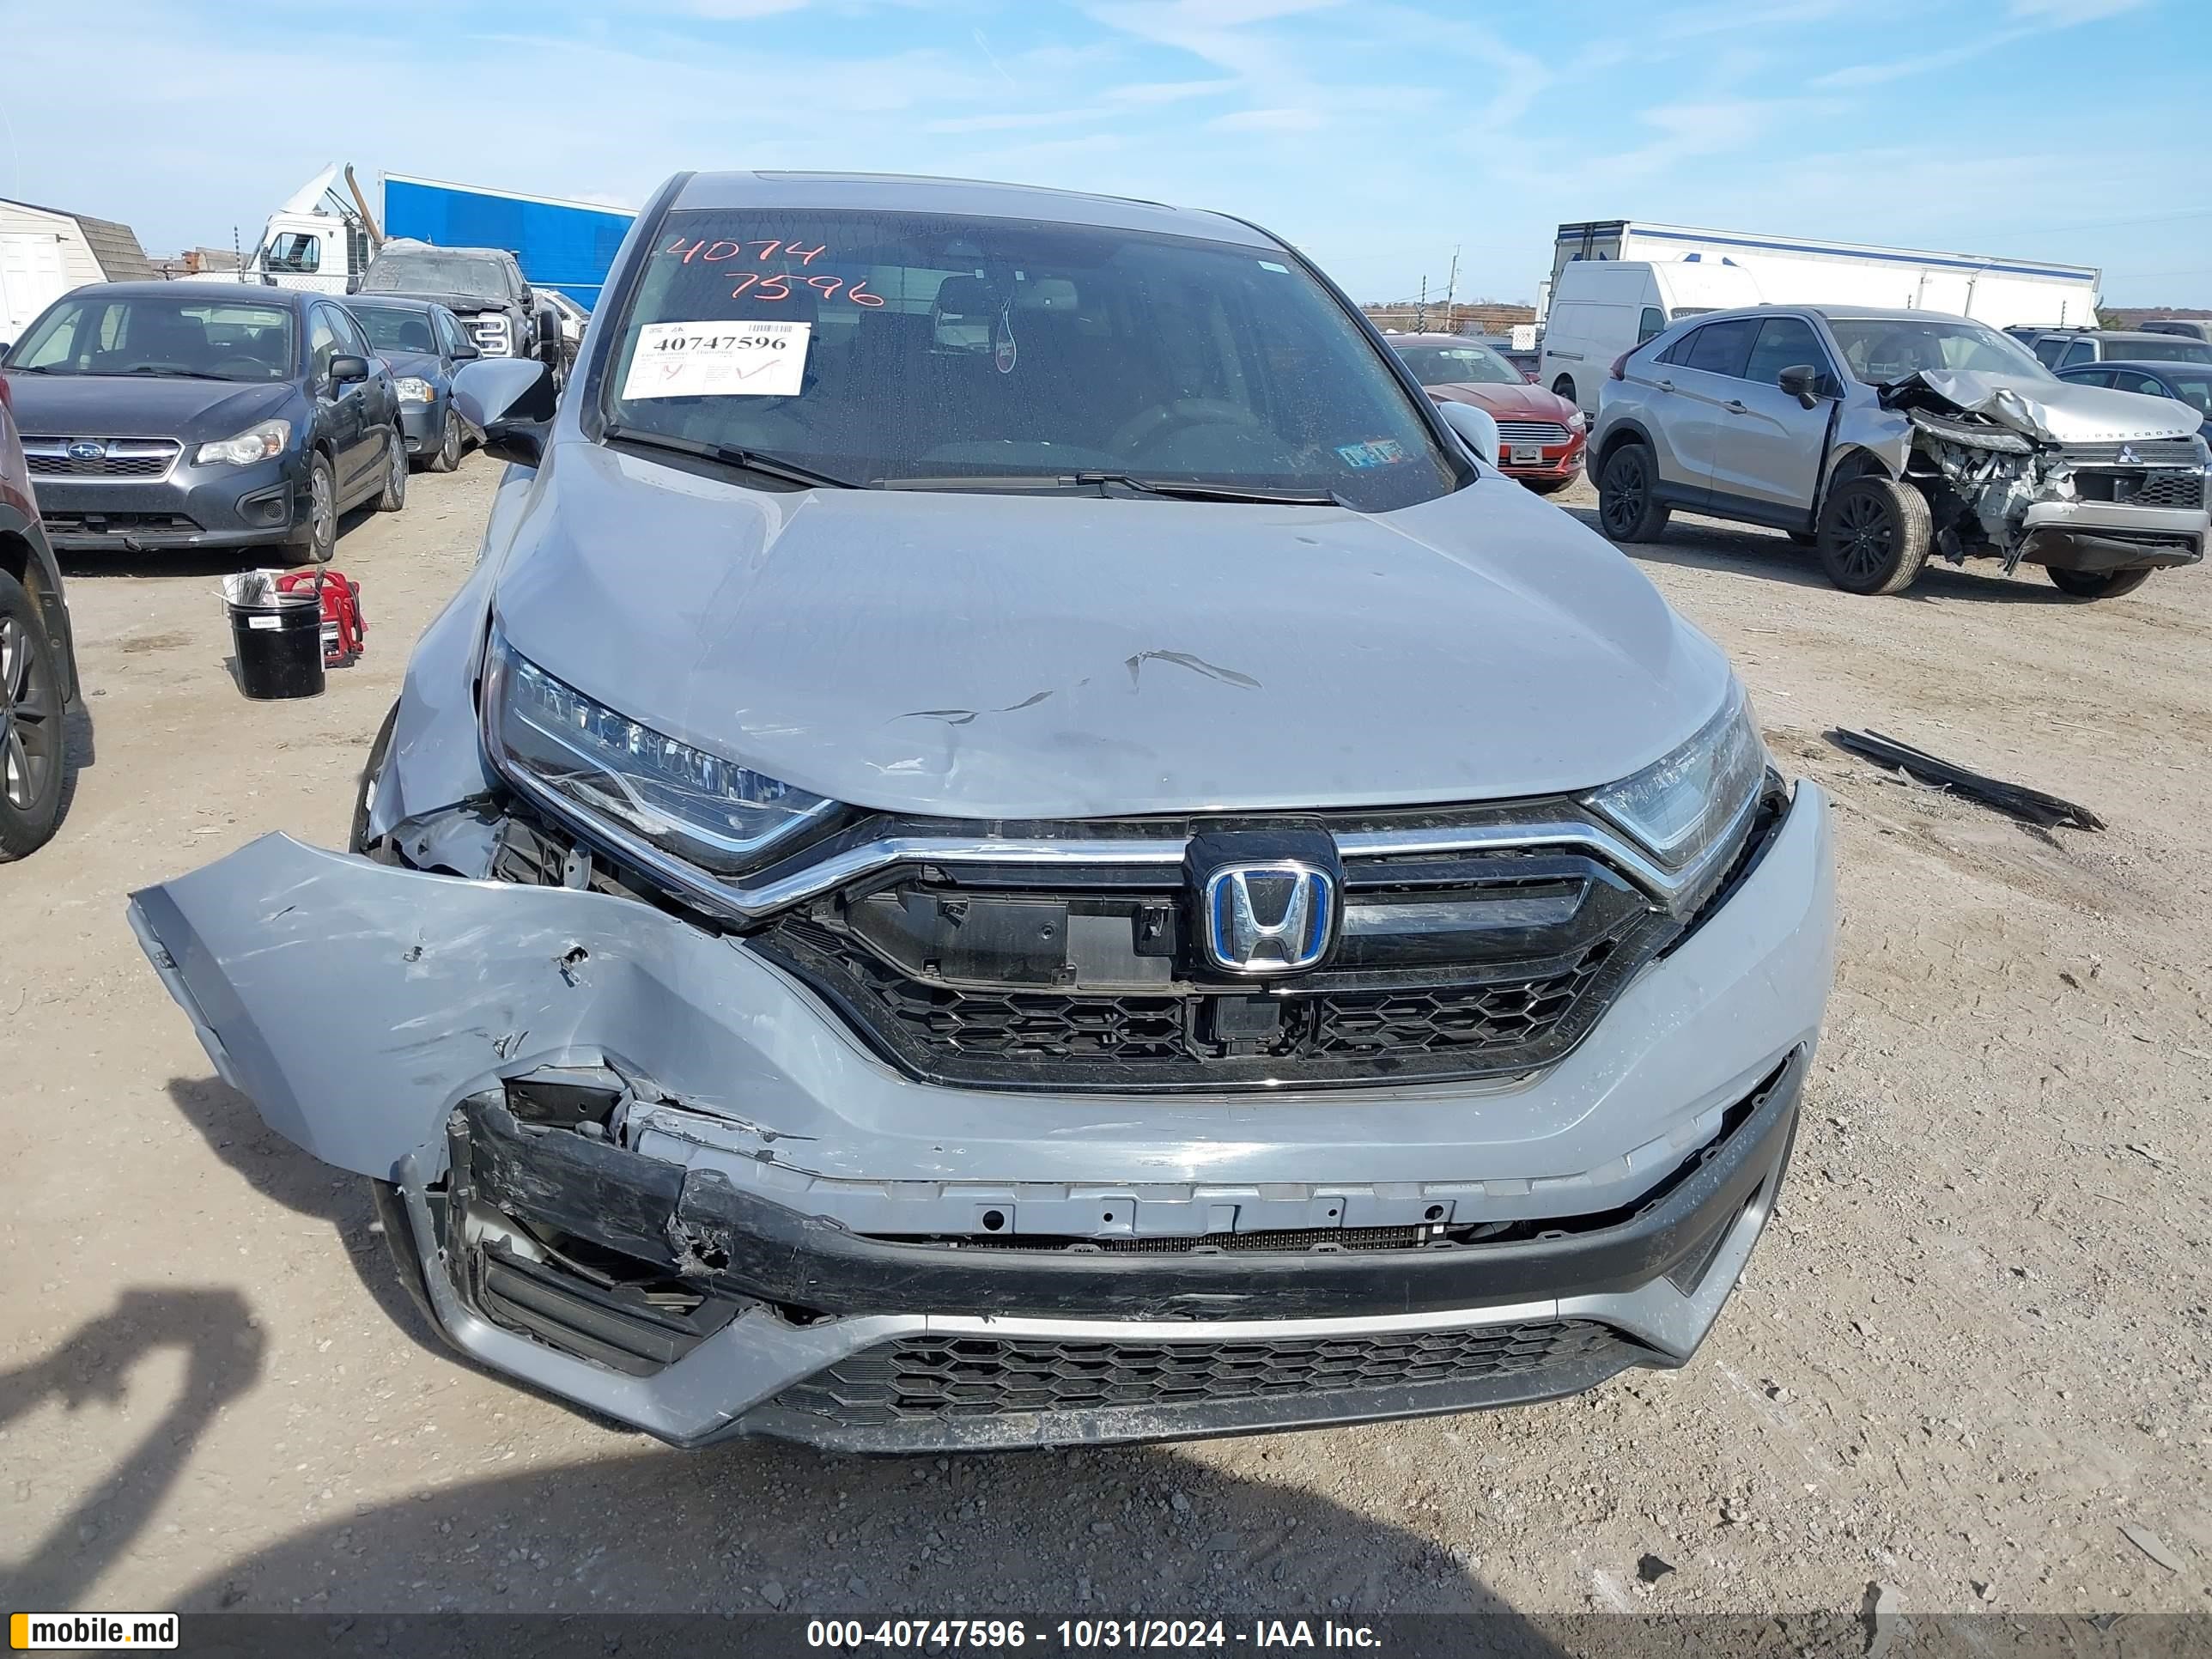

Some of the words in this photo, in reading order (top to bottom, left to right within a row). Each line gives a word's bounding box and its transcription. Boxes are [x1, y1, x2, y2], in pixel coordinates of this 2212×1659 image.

[667, 238, 825, 264] 4074
[725, 273, 884, 307] 7596
[653, 337, 787, 350] 40747596
